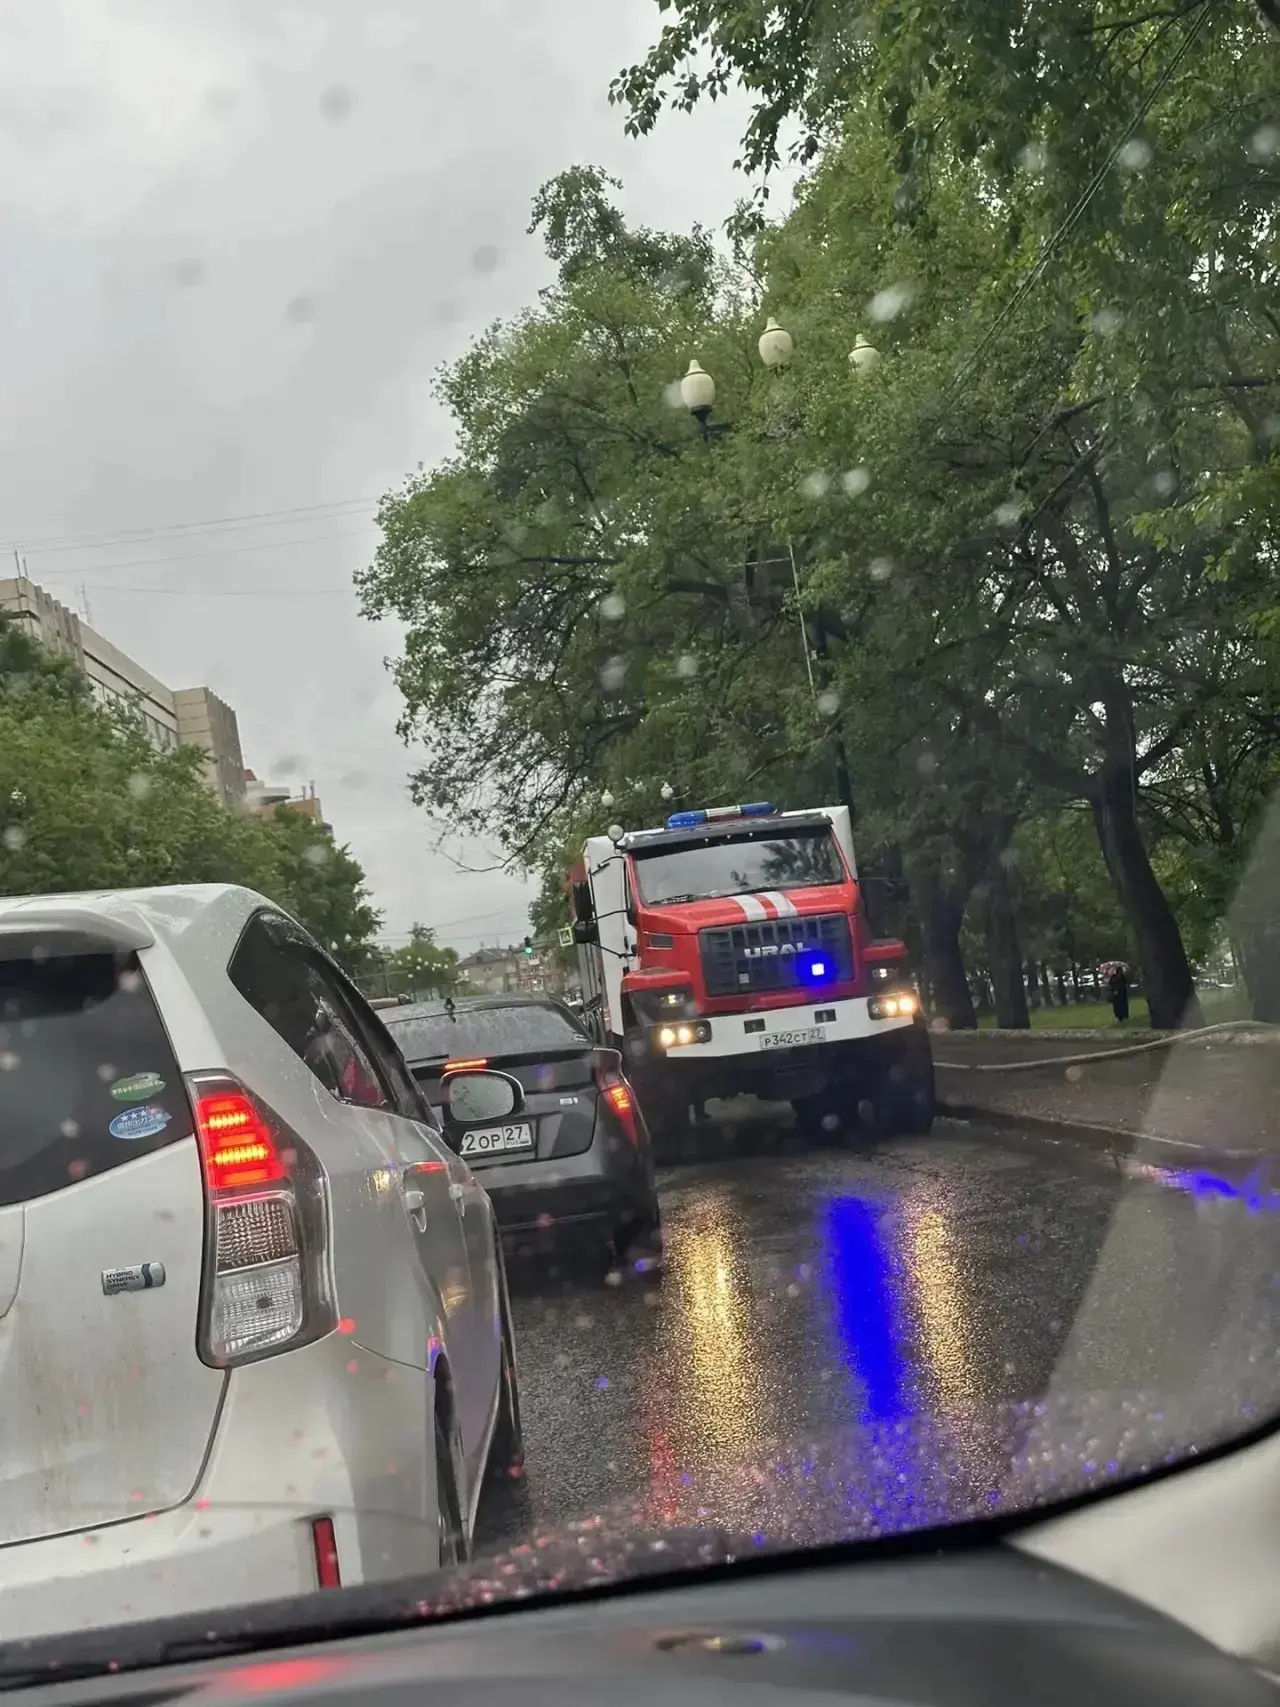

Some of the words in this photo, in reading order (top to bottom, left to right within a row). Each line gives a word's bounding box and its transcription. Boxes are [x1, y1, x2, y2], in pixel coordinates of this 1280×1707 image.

[743, 942, 812, 958] URAL
[505, 1126, 523, 1141] 27
[106, 1270, 134, 1279] HYBRID
[106, 1275, 140, 1285] SYNERGY
